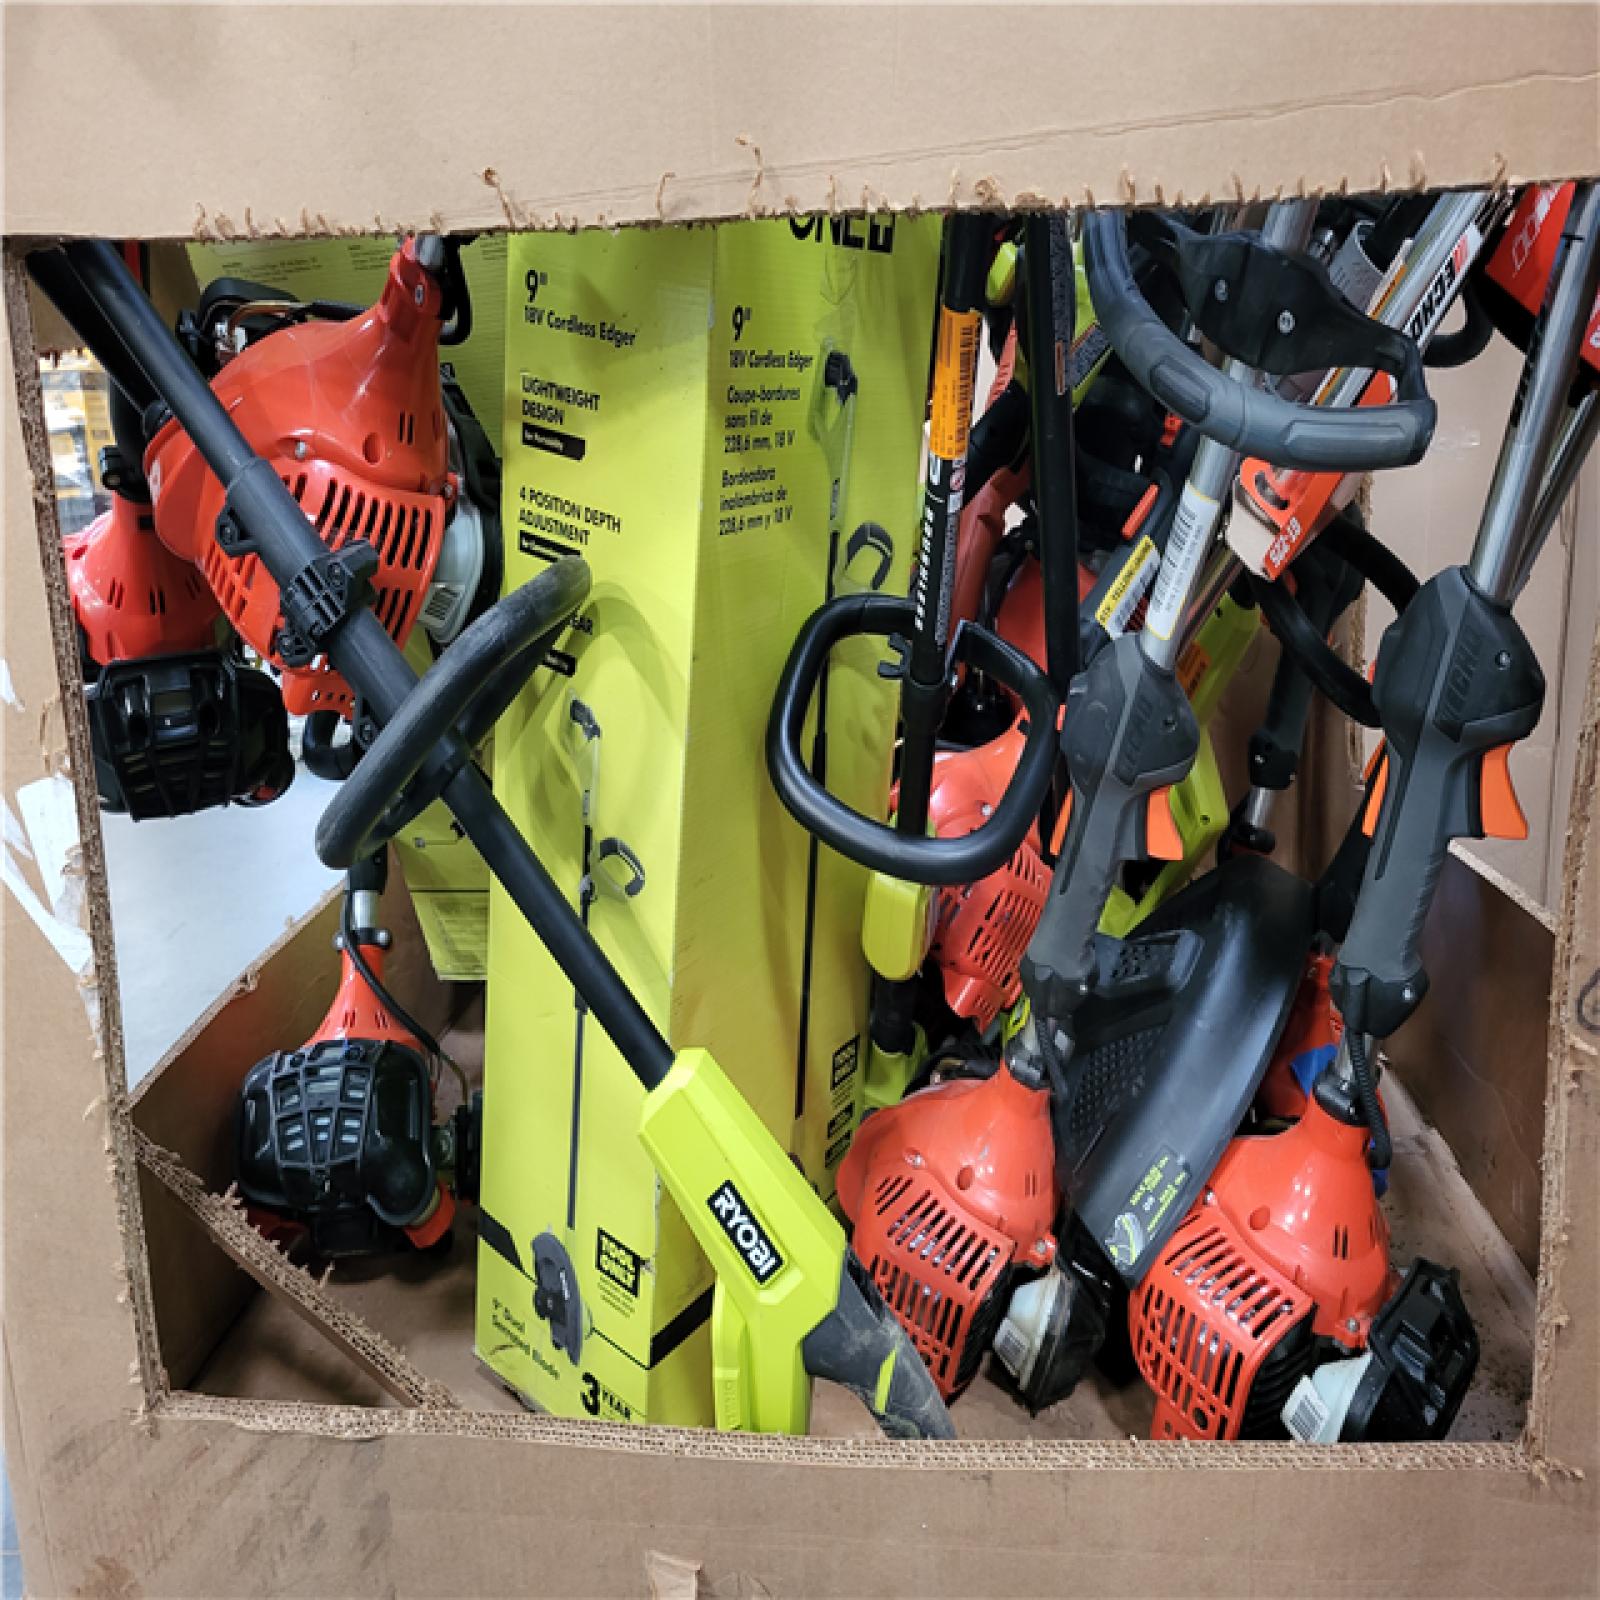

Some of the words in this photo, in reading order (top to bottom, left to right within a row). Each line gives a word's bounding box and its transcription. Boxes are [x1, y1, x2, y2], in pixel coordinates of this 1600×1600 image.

[525, 269, 548, 302] 9"
[1408, 254, 1457, 342] ECHO
[524, 305, 545, 325] 18V
[547, 310, 596, 338] Cordless
[600, 321, 636, 348] Edger
[732, 305, 751, 342] 9"
[729, 350, 746, 368] 18V
[749, 350, 785, 368] Cordless
[788, 350, 813, 373] Edger
[522, 375, 600, 411] LIGHTWEIGHT
[728, 385, 801, 406] Coupe-bordures
[522, 400, 564, 425] DESIGN
[725, 414, 747, 428] sans
[760, 408, 772, 425] de
[775, 431, 785, 448] 18
[722, 465, 776, 488] Bordeadora
[775, 485, 787, 501] de
[519, 508, 591, 546] ADJUSTMENT
[529, 488, 581, 520] POSITION
[584, 506, 622, 535] DEPTH
[713, 1185, 777, 1276] RYOBI
[580, 1371, 600, 1416] 3
[602, 1388, 631, 1421] YEAR
